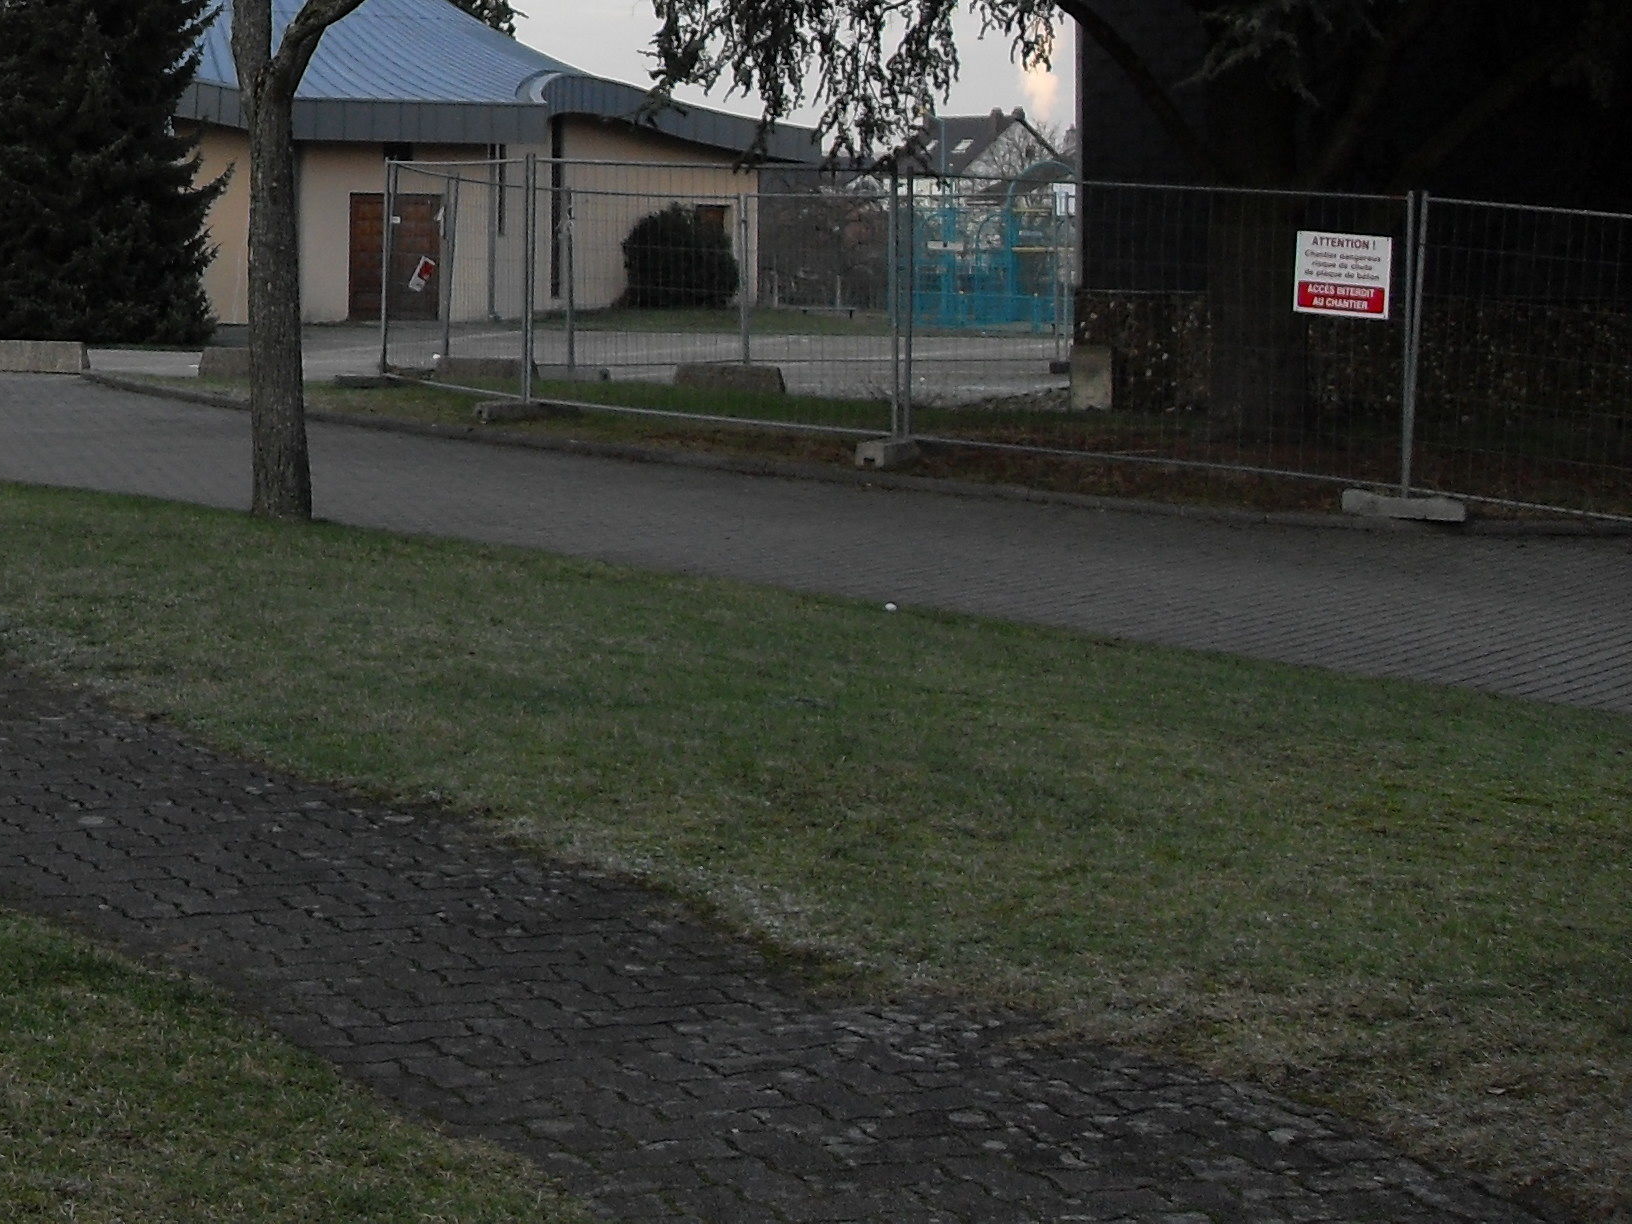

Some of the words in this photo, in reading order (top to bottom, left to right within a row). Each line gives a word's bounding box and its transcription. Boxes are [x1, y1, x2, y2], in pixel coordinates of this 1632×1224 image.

[1312, 236, 1369, 249] ATTENTION
[1336, 286, 1375, 298] INTERDIT
[1312, 296, 1324, 306] AU
[1325, 297, 1368, 310] CHANTIER
